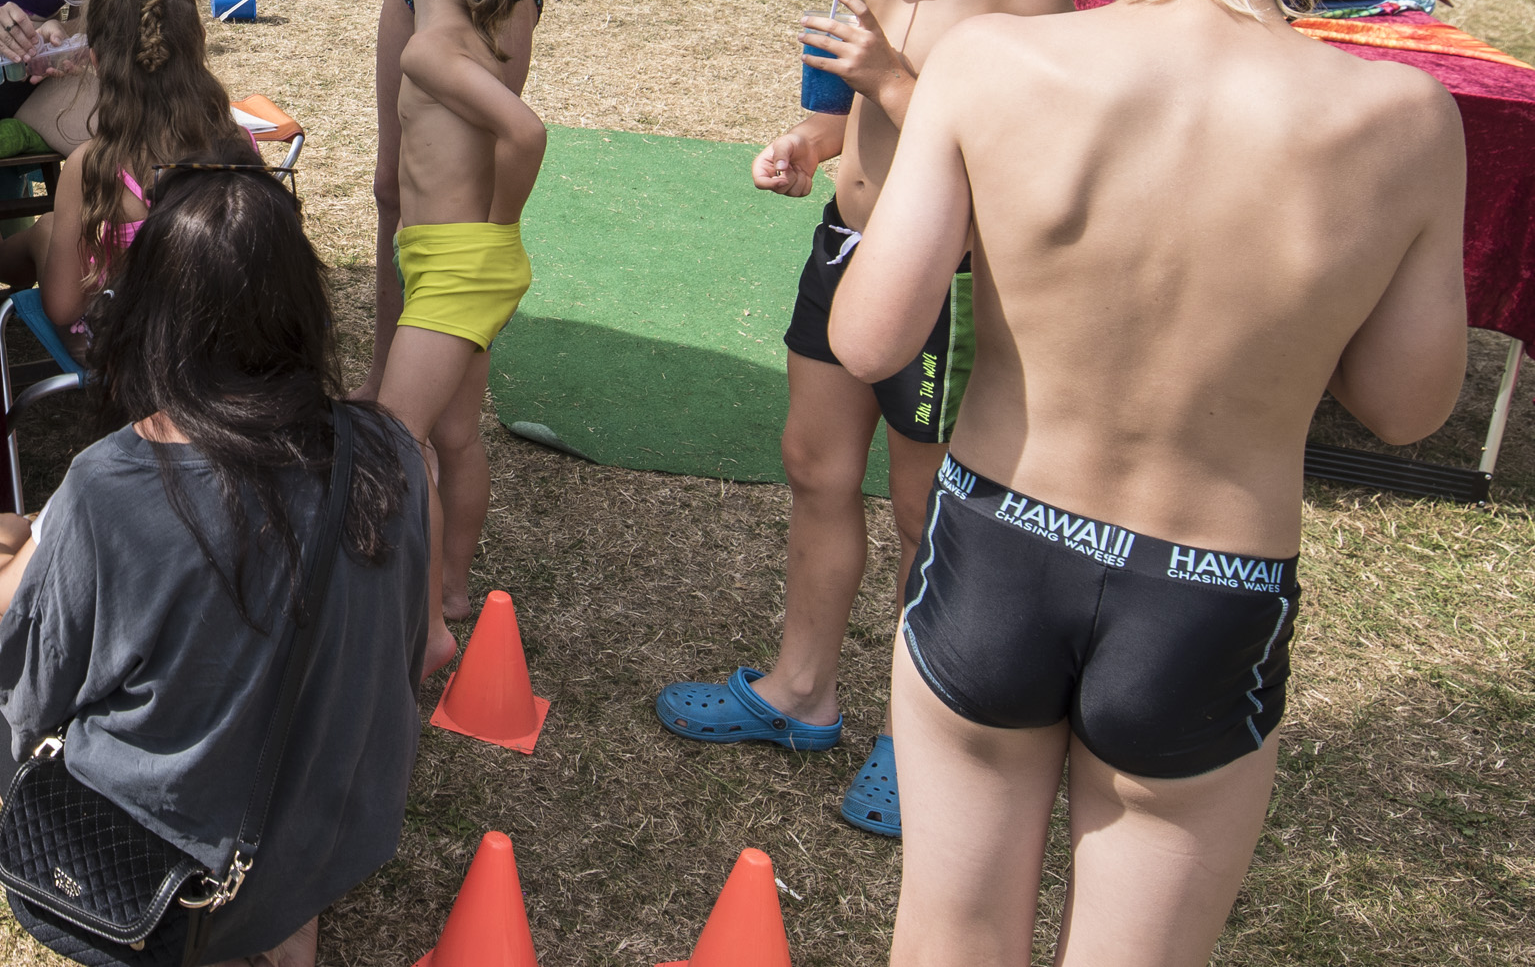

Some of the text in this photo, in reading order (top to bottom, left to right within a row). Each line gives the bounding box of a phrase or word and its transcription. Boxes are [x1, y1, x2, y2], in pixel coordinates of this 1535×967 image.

[914, 351, 938, 426] TAKE THE WAVE
[941, 452, 977, 494] WAII
[943, 477, 968, 501] WAVES
[994, 510, 1059, 542] CHASING
[1167, 569, 1281, 593] CHASING WAVES
[1169, 545, 1284, 584] HAWAII
